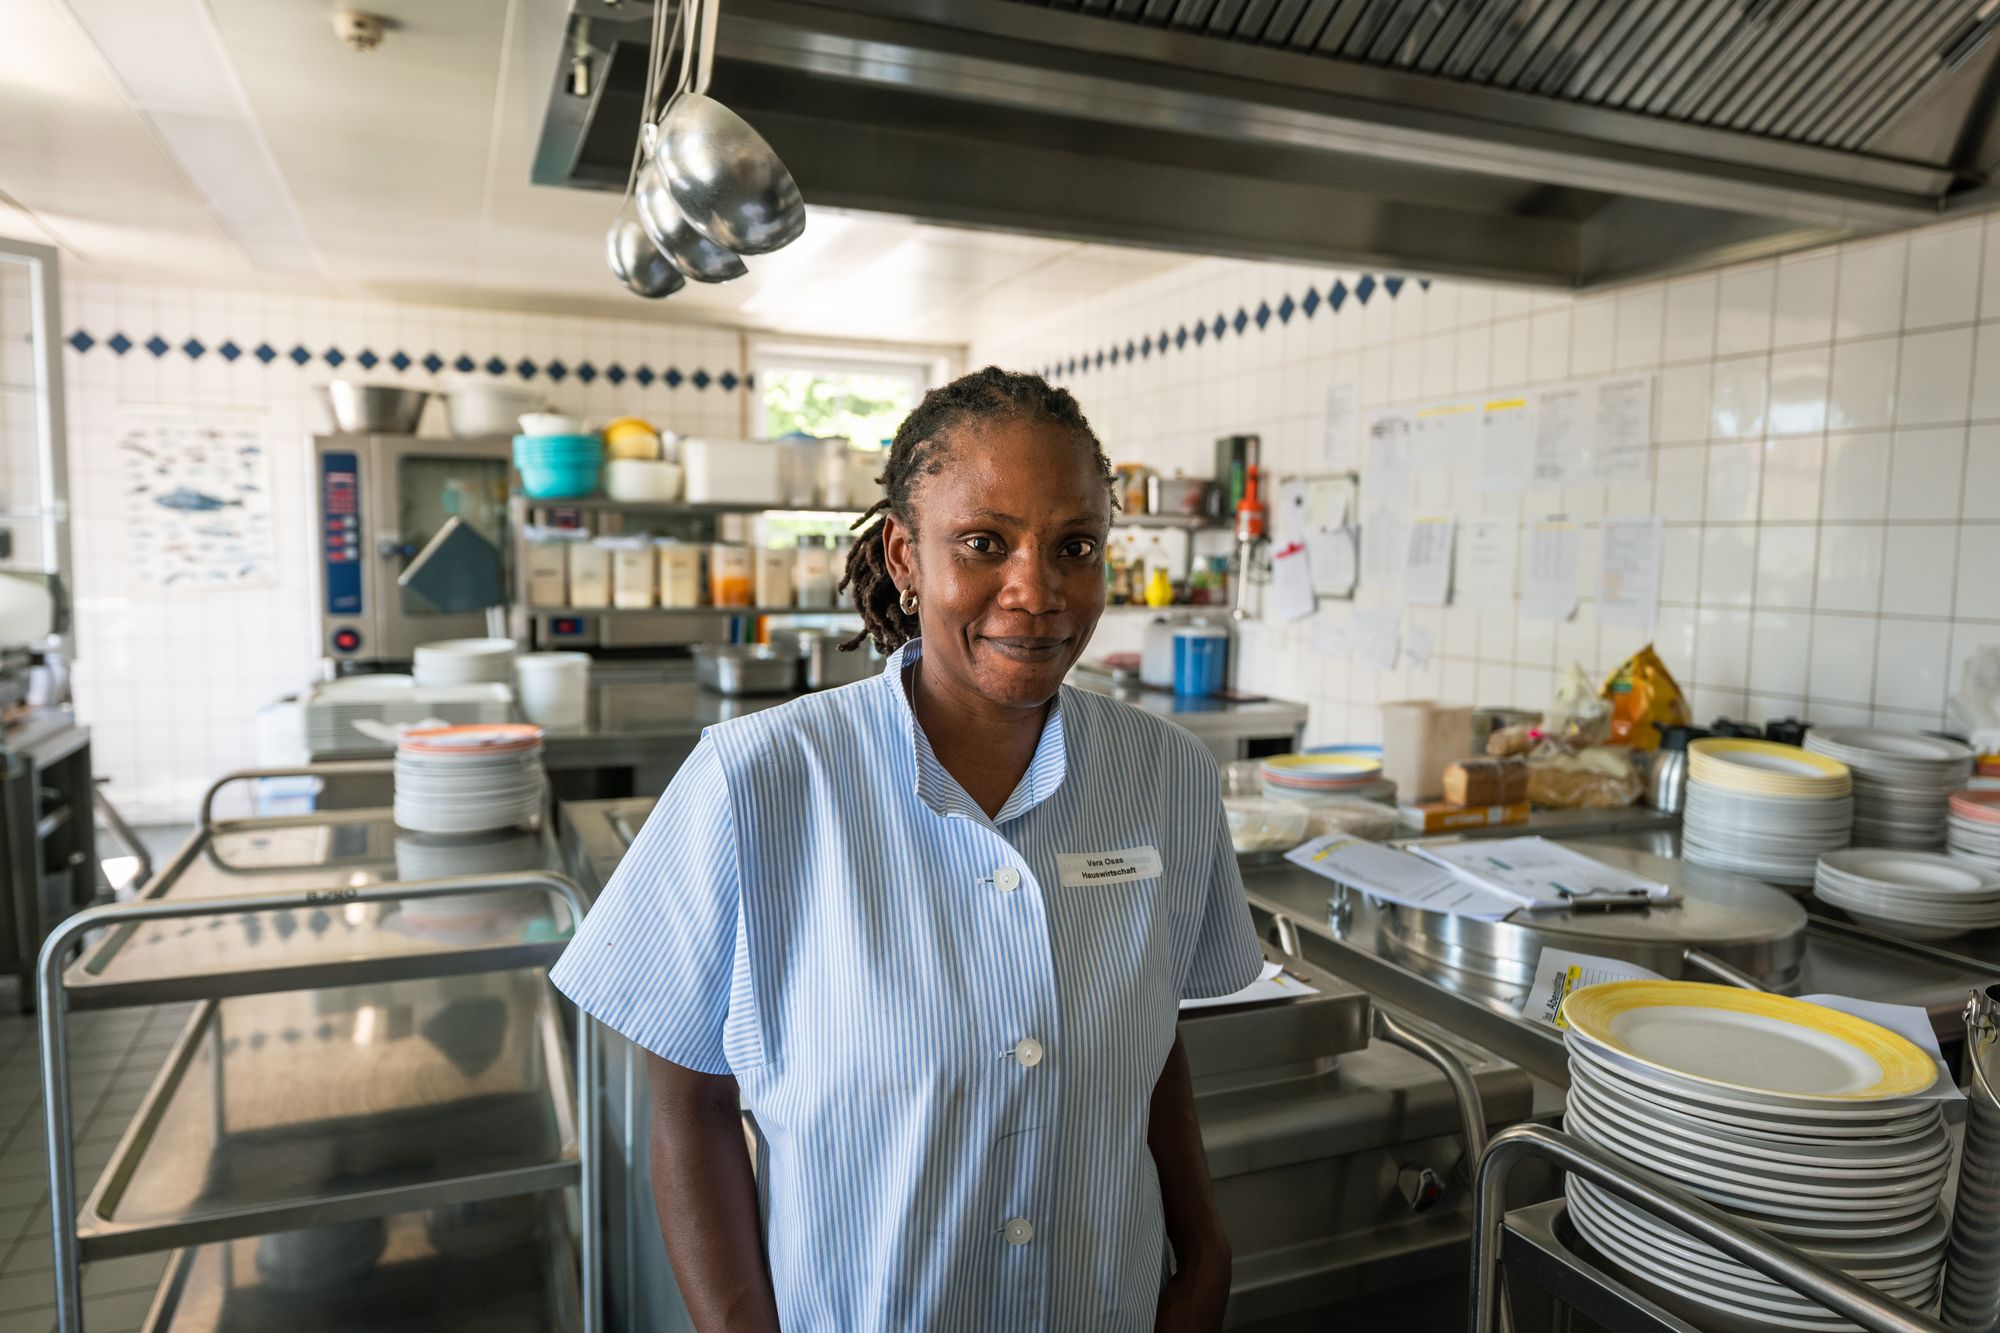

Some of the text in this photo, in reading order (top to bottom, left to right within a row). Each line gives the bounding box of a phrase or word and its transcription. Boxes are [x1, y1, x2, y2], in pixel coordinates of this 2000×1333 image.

[1086, 857, 1124, 867] Vera Osas
[1082, 866, 1137, 879] Hauswirtschaft
